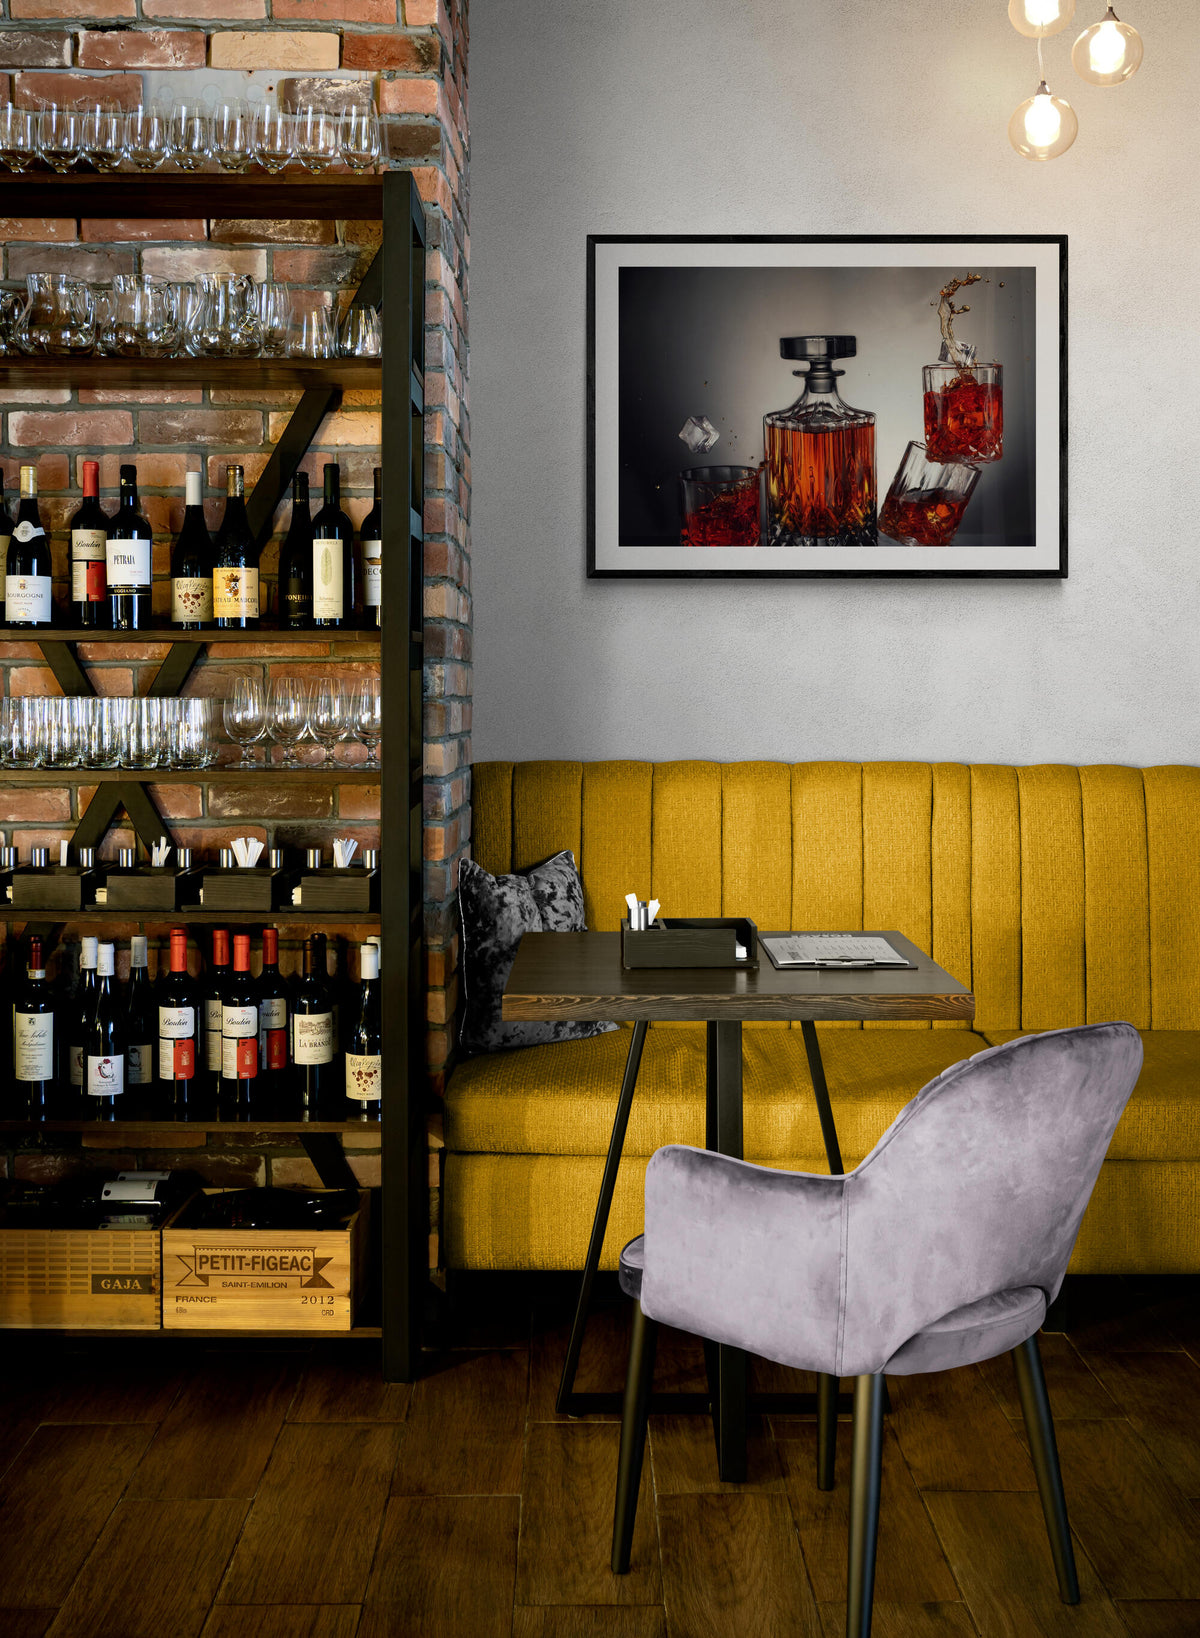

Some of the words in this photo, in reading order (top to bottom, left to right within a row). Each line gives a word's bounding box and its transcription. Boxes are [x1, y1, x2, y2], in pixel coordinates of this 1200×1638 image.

[113, 554, 136, 565] PETRAIA
[199, 1254, 312, 1272] PETIT-FIGEAC
[100, 1279, 142, 1290] GAJA
[176, 1296, 217, 1304] FRANCE
[301, 1295, 334, 1305] 2012
